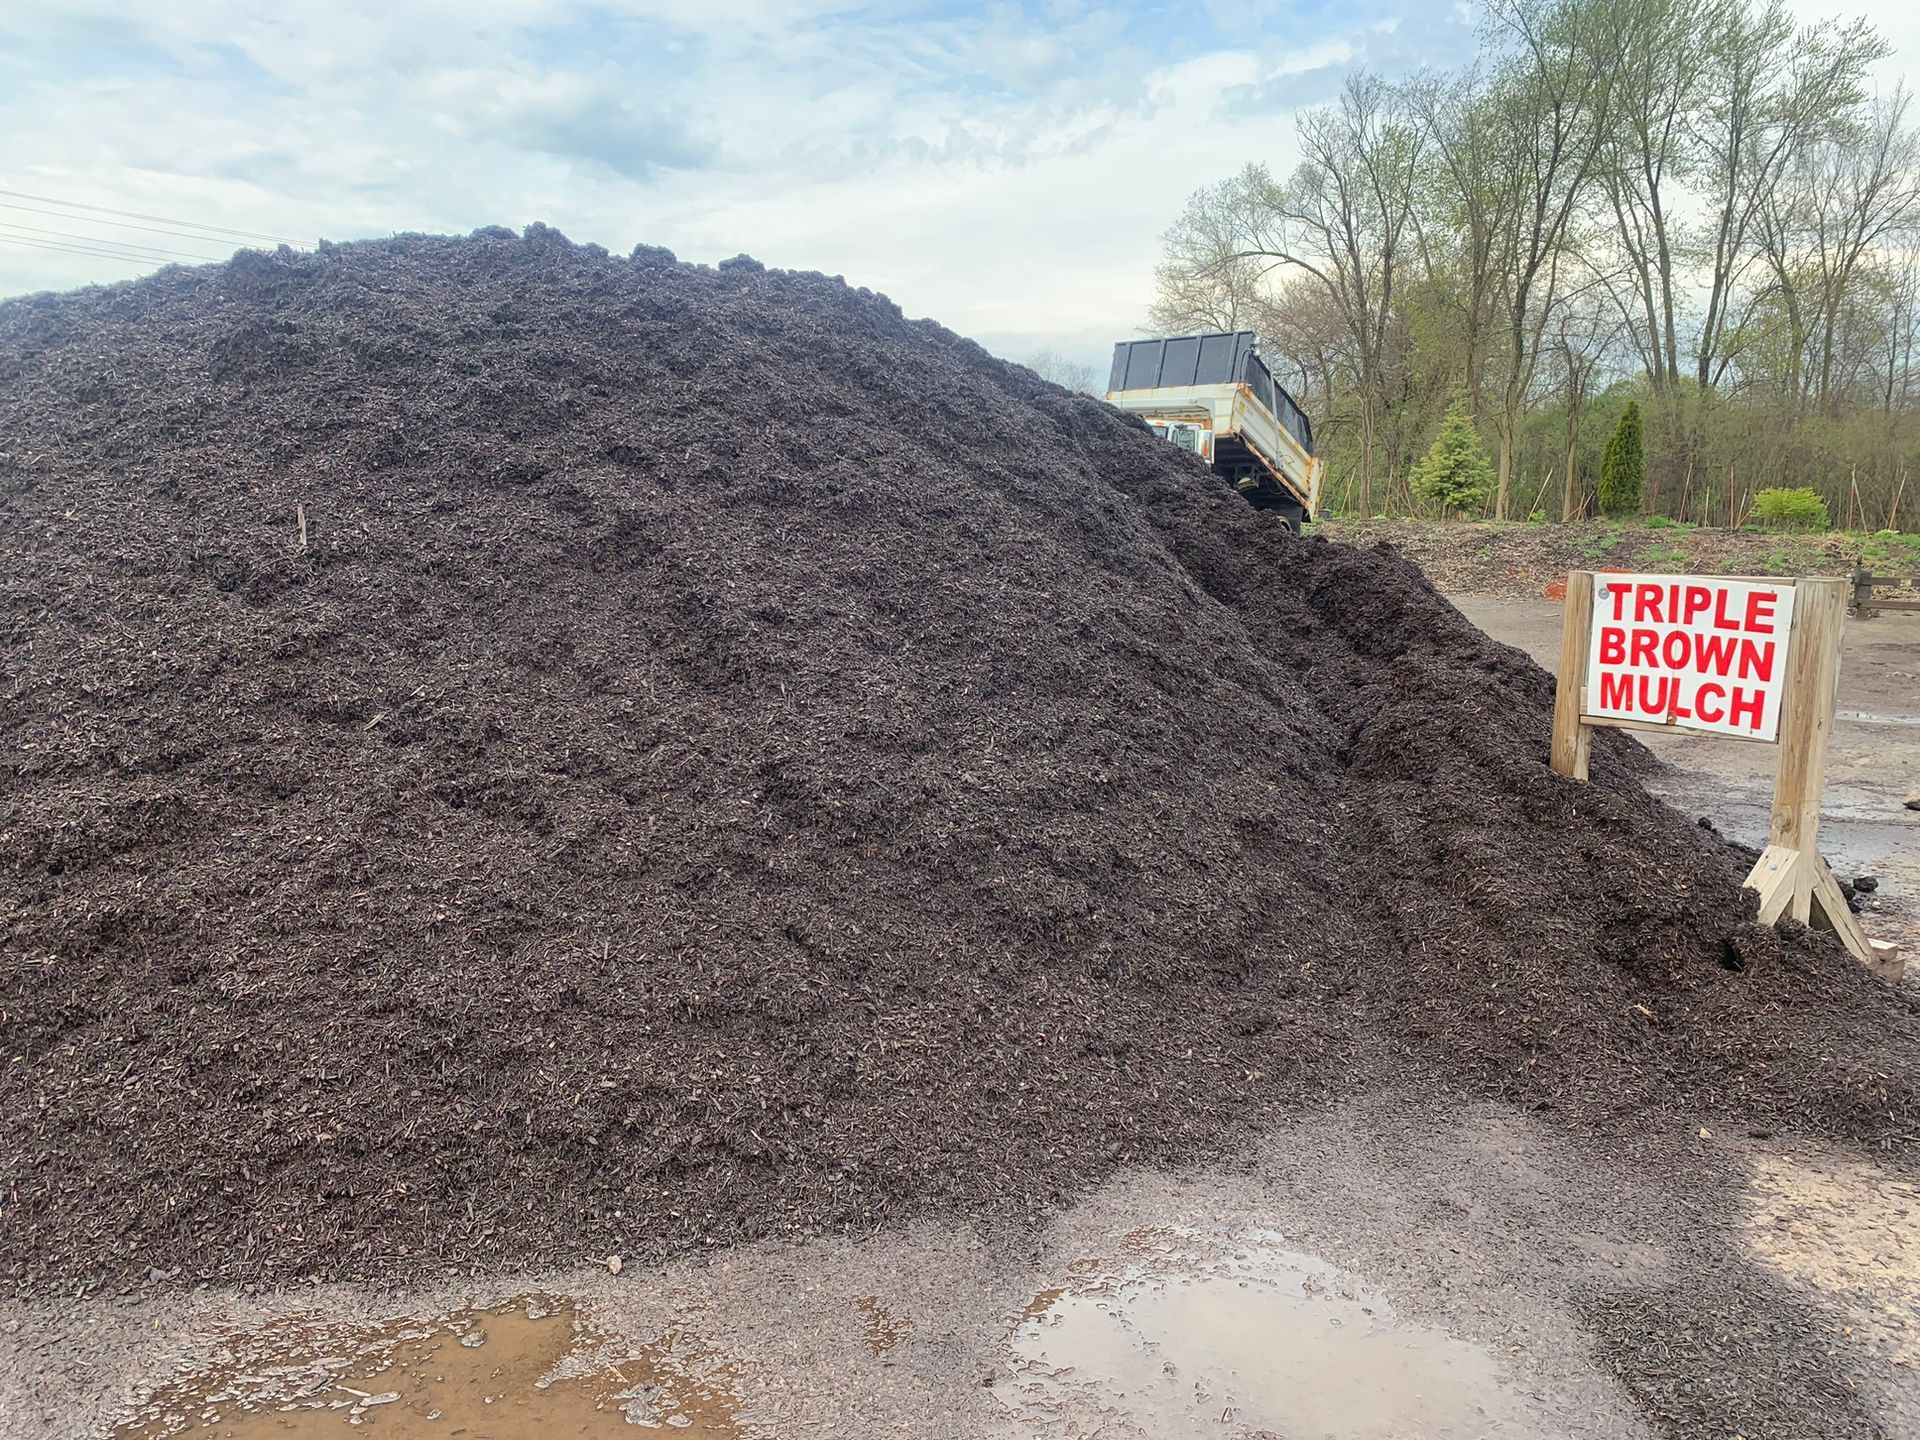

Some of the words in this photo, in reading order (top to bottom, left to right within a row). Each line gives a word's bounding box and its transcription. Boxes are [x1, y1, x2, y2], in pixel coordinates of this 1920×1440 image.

[1606, 583, 1778, 635] TRIPLE
[1599, 627, 1776, 682] BROWN
[1599, 672, 1766, 731] MULCH
